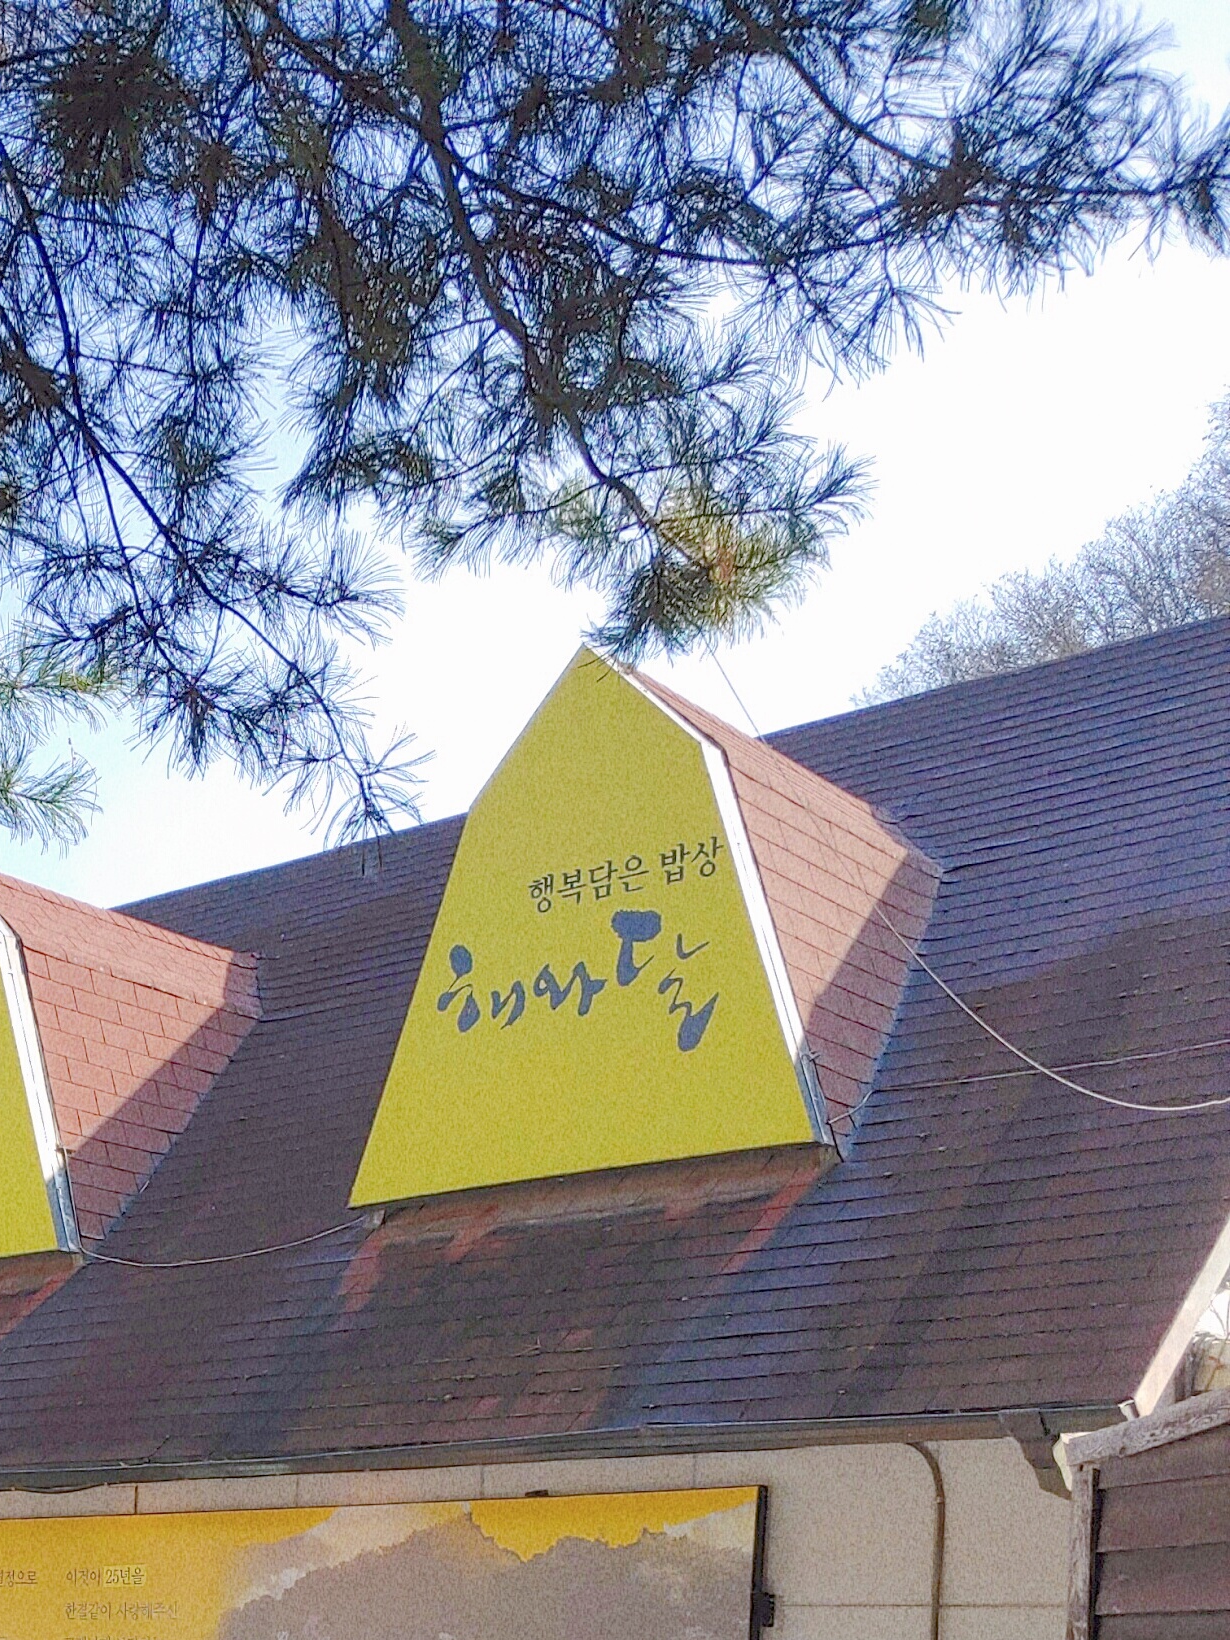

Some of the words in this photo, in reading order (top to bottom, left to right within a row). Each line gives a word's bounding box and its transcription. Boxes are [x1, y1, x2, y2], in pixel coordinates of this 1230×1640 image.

[528, 854, 650, 914] 행복담은
[659, 836, 724, 886] 밥상
[105, 1566, 145, 1586] 25년을
